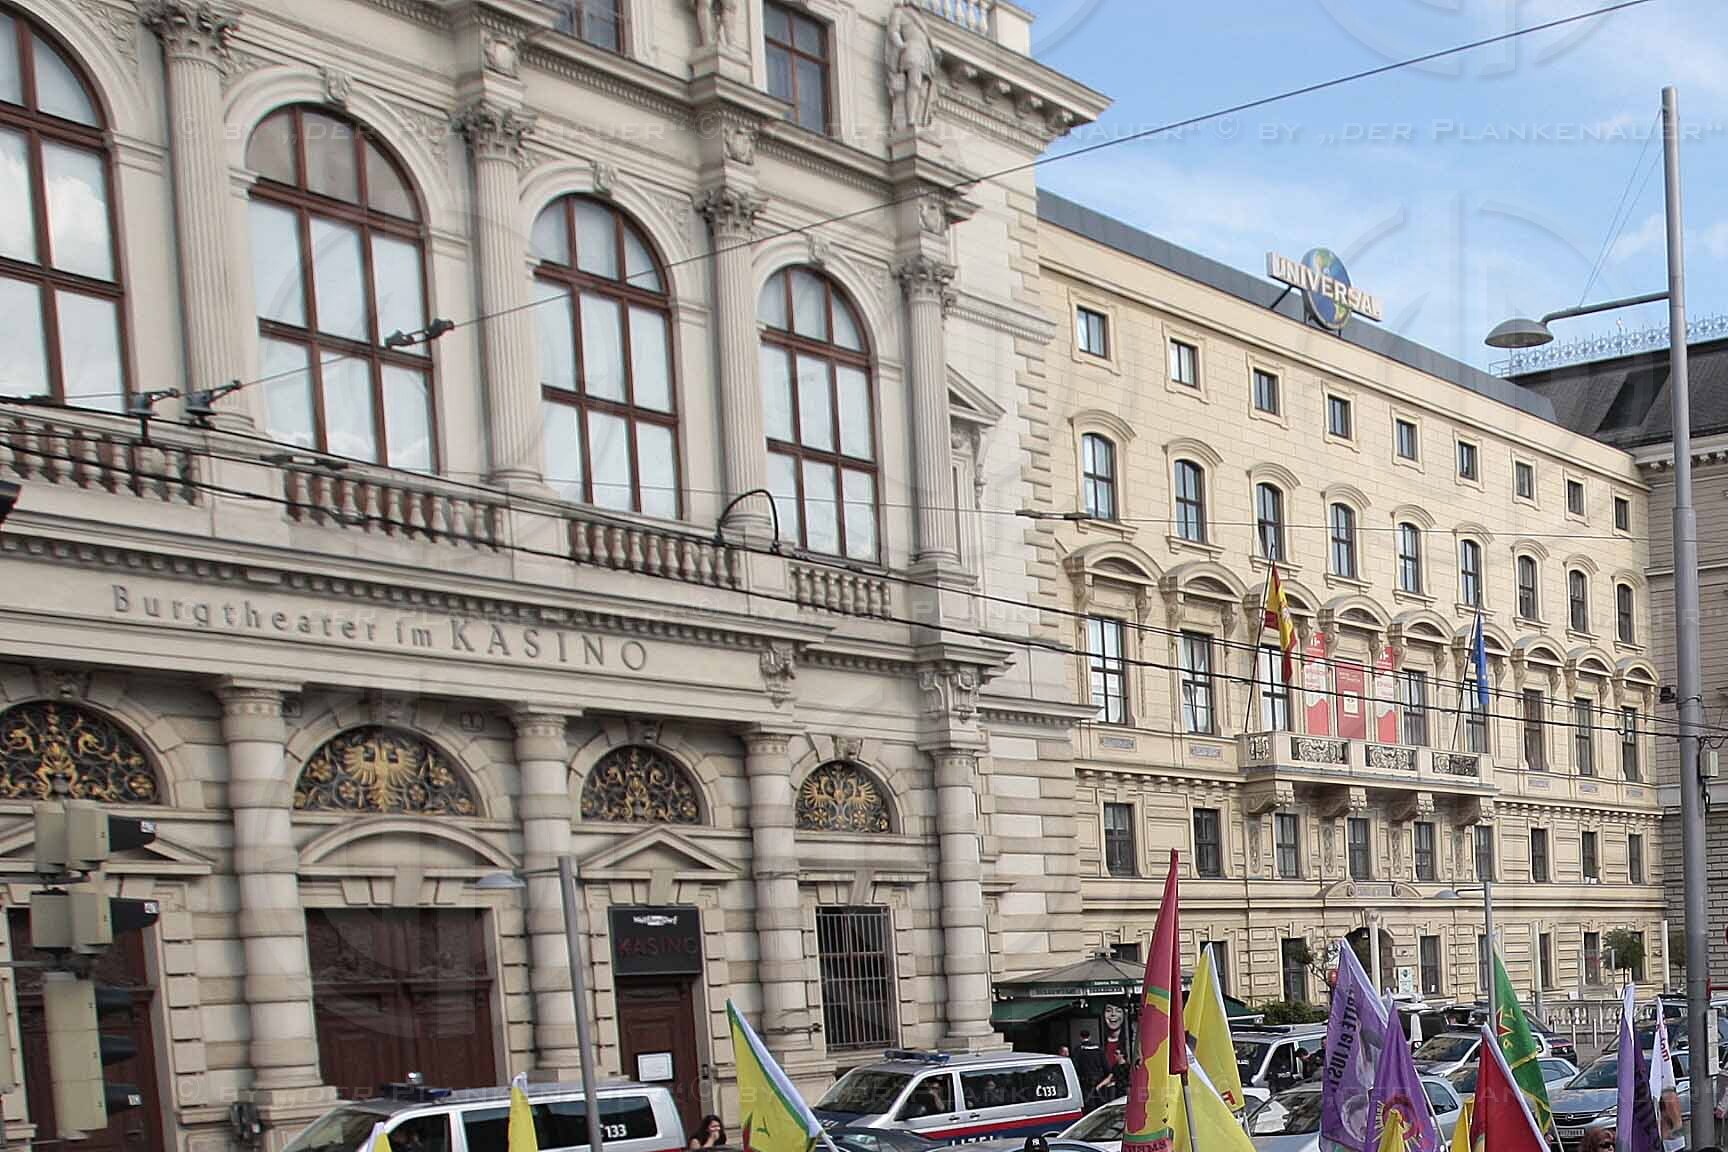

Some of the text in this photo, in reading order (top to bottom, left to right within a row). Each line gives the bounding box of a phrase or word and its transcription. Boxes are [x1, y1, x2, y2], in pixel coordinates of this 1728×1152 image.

[1267, 252, 1382, 320] UNIVERSAL
[111, 584, 649, 671] Burgtheater im KASINO
[1043, 1086, 1057, 1097] 133
[604, 1123, 627, 1139] 133
